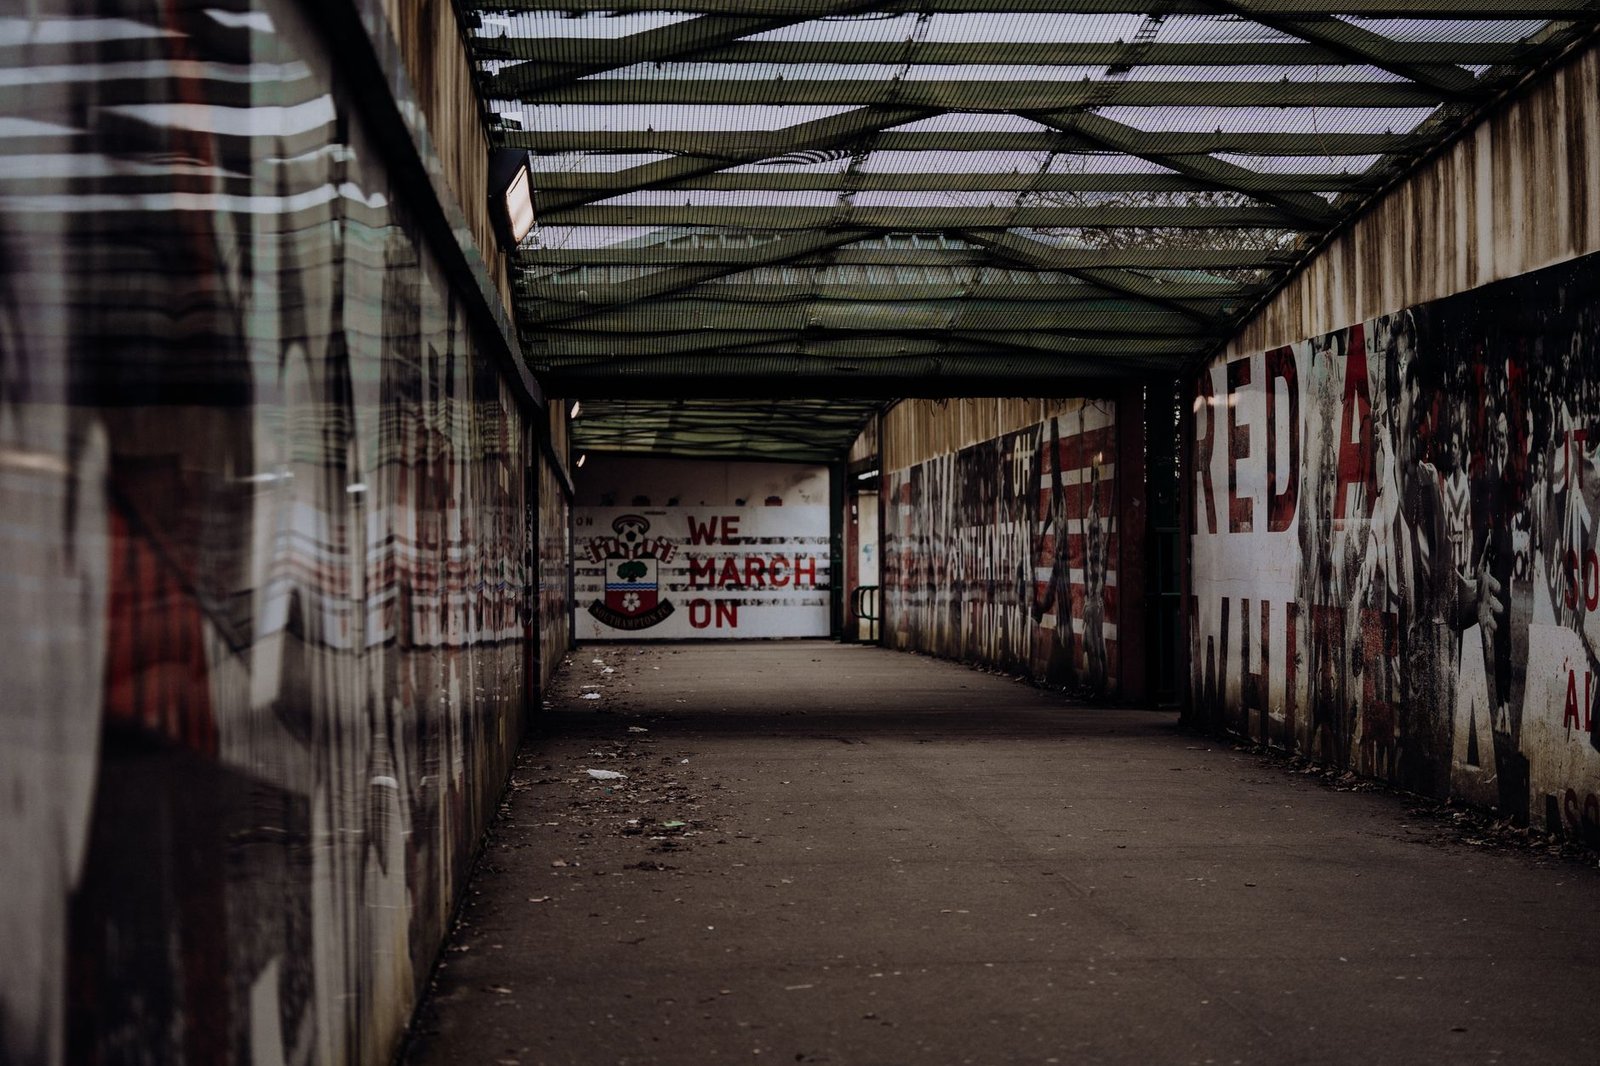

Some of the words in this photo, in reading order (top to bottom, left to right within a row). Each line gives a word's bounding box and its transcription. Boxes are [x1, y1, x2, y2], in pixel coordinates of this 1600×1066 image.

[1191, 345, 1300, 535] RED
[1012, 432, 1031, 496] OH
[575, 517, 593, 526] ON
[687, 516, 740, 546] WE
[689, 556, 816, 588] MARCH
[689, 599, 737, 629] ON
